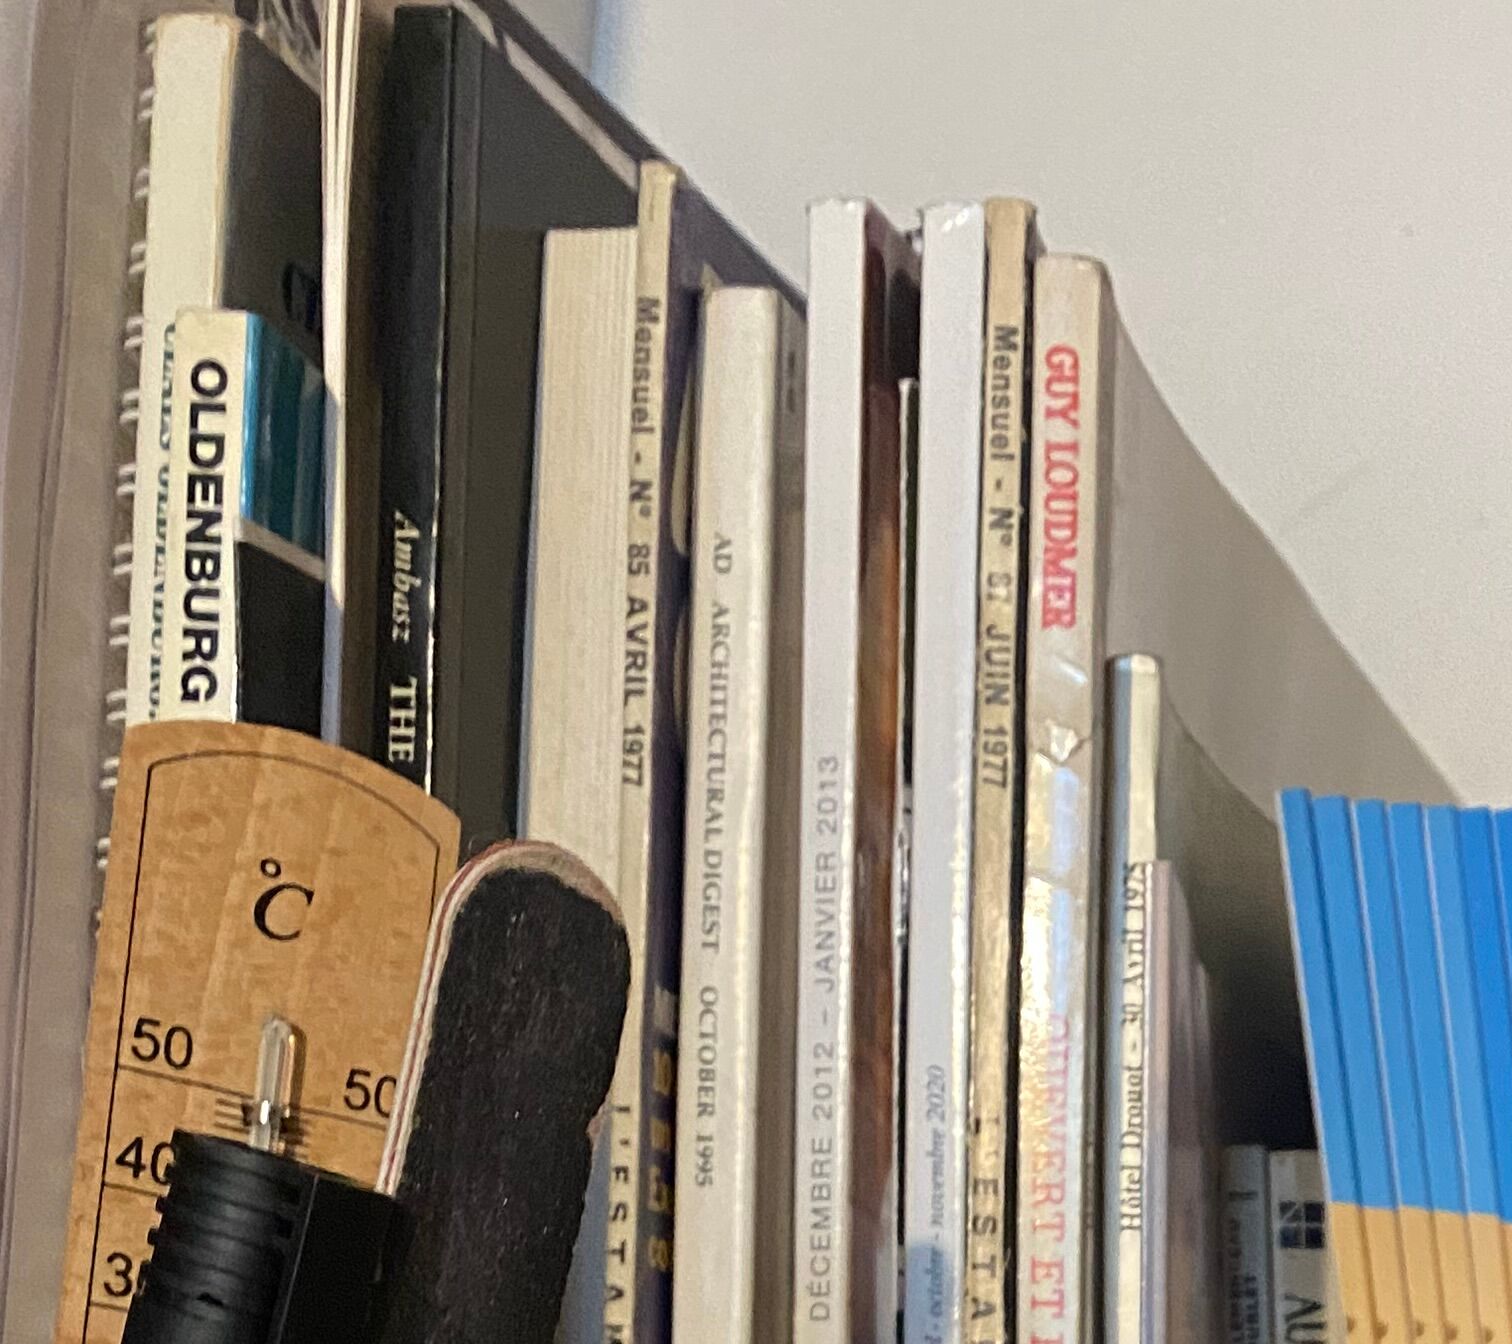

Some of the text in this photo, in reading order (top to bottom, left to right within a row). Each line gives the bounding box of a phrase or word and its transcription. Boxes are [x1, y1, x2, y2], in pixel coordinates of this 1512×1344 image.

[633, 297, 661, 439] Mensuel
[990, 325, 1020, 461] Mensuel
[1040, 344, 1079, 631] GUY LOUDMER
[179, 358, 228, 706] OLDENBURG
[627, 543, 651, 580] 85
[388, 509, 421, 763] Ambasz THE
[625, 596, 651, 709] AVRIL
[984, 624, 1012, 706] JUIN
[621, 727, 645, 787] 1977
[817, 755, 839, 835] 2013
[980, 724, 1009, 788] 1977
[695, 533, 731, 1189] AD ARCHITECTURAL DIGEST OCTOBER 1995
[813, 848, 839, 991] JANVIER
[129, 1016, 194, 1071] 50
[813, 1041, 836, 1122] 2012
[926, 1064, 945, 1122] 2020
[807, 1137, 835, 1323] DÉCEMBRE
[1121, 1168, 1142, 1232] Hôtel
[1030, 1258, 1065, 1319] ET
